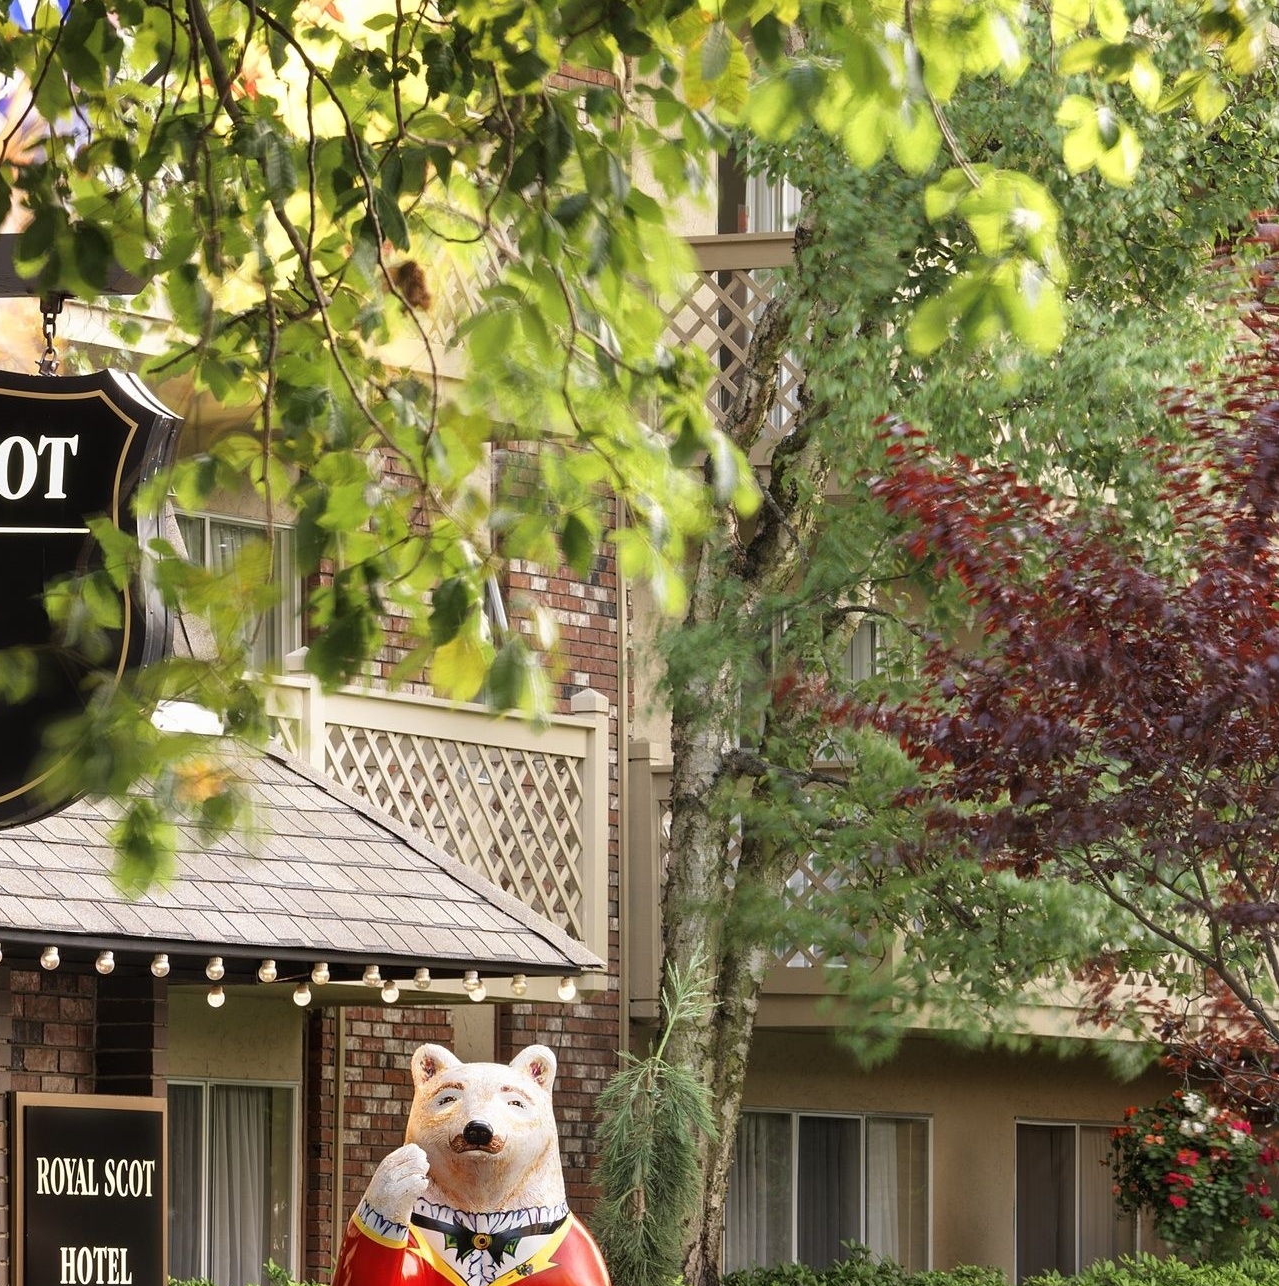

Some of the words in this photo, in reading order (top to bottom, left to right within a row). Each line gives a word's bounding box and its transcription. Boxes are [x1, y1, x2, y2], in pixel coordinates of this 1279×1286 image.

[36, 1156, 99, 1196] ROYAL
[104, 1158, 156, 1198] SCOT
[59, 1245, 133, 1286] HOTEL
